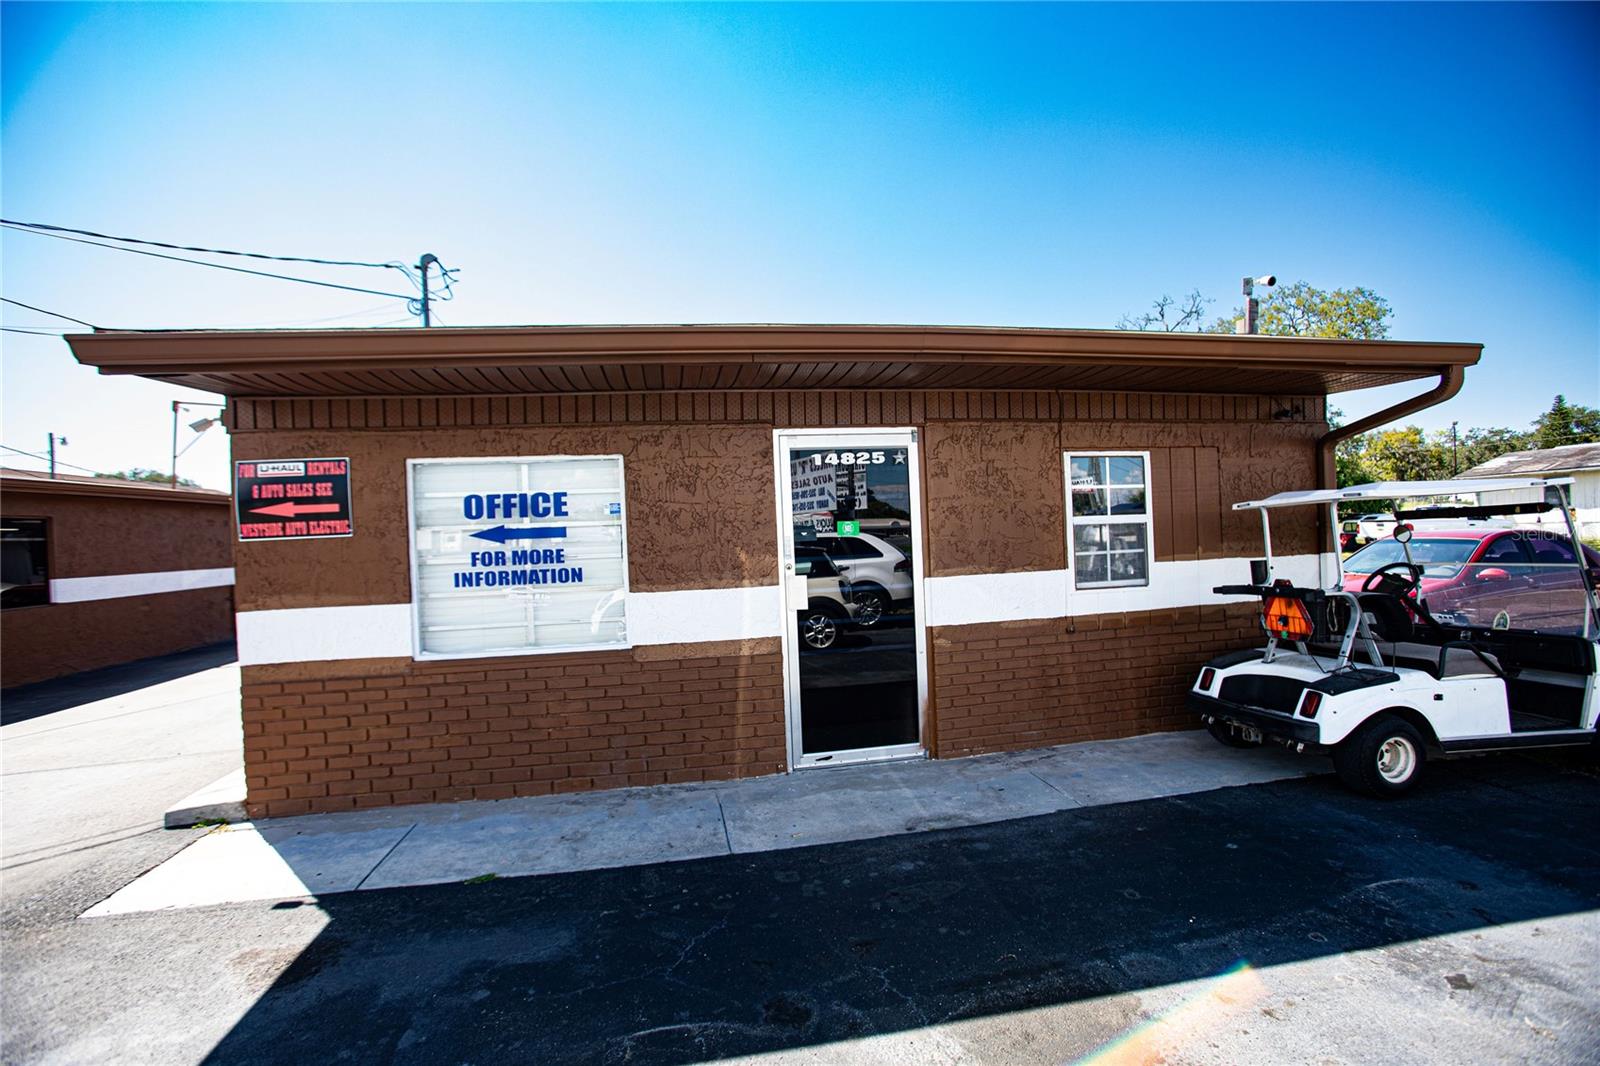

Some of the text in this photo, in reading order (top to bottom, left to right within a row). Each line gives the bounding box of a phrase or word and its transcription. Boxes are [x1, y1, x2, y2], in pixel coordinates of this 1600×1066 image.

[811, 451, 886, 465] 14825
[239, 462, 346, 478] FOR U-HAUL RENTALS
[261, 484, 284, 499] AUTO
[286, 483, 313, 497] SALES
[315, 482, 333, 496] SEE
[463, 491, 569, 520] OFFICE
[240, 519, 349, 537] WESTSIDE AUTO ELECTRIC
[470, 548, 565, 567] FOR MORE
[454, 567, 583, 588] INFORMATION
